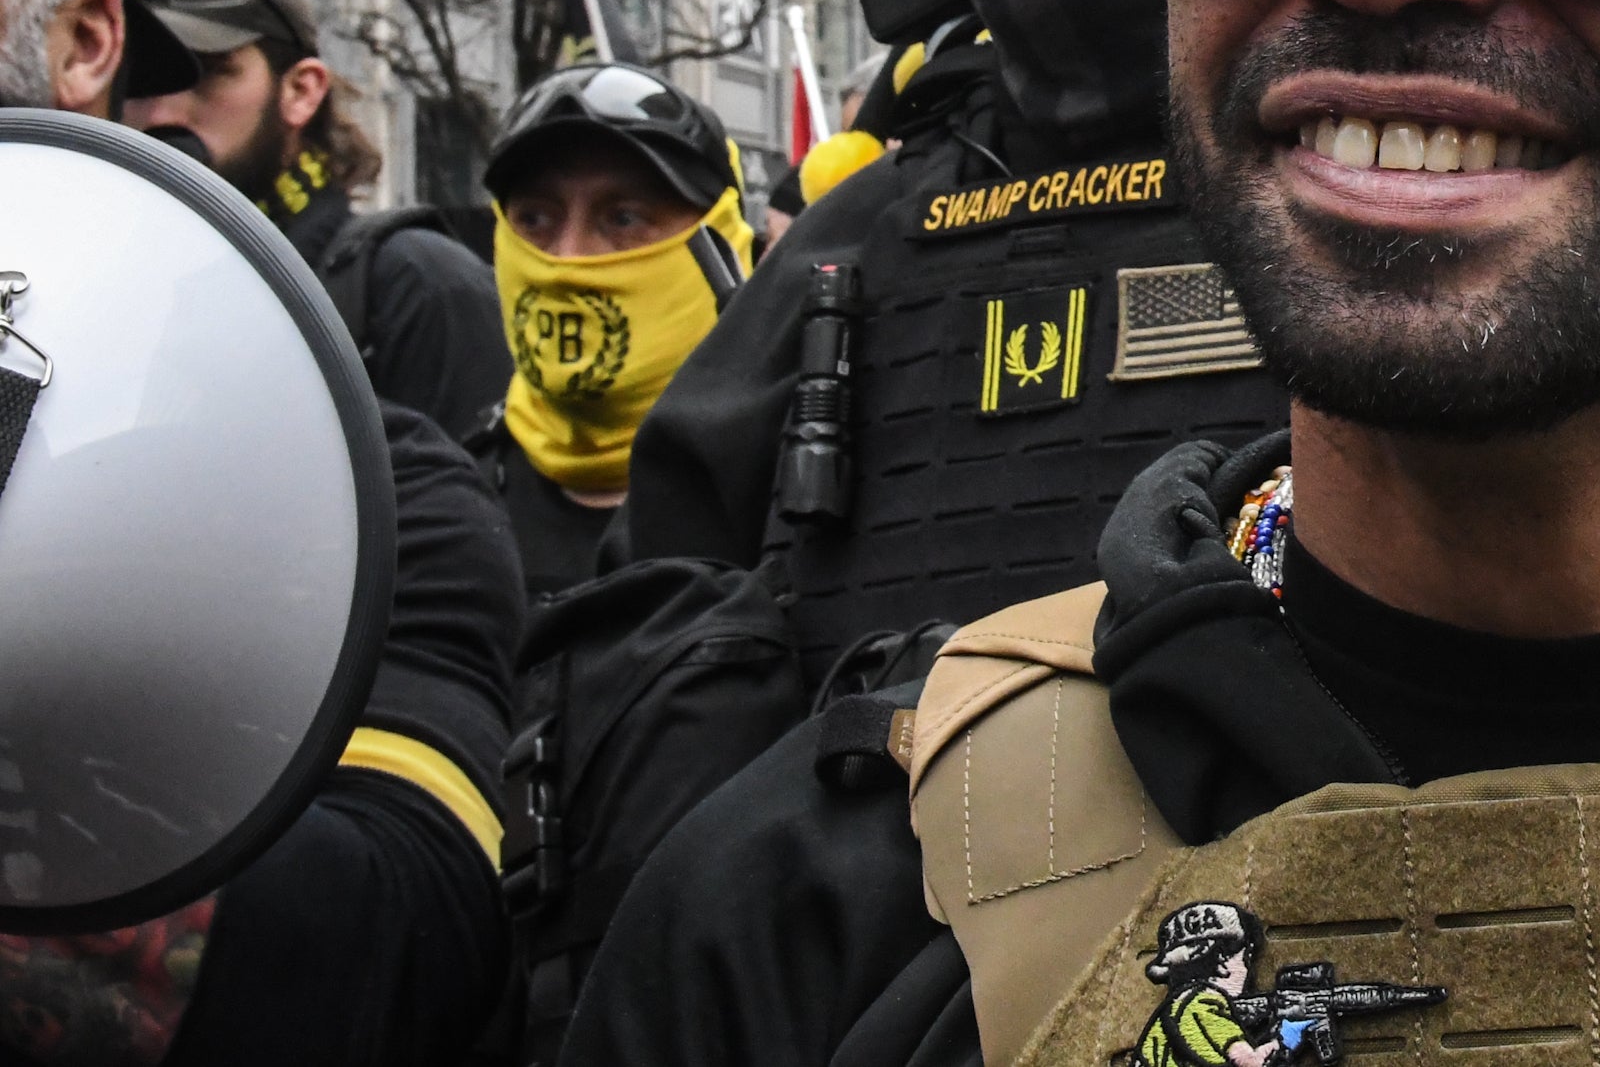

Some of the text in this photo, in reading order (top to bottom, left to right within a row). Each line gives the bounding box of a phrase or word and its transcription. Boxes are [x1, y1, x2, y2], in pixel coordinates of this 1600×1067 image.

[923, 158, 1167, 231] SWAMP CRACKER
[533, 308, 584, 364] PB
